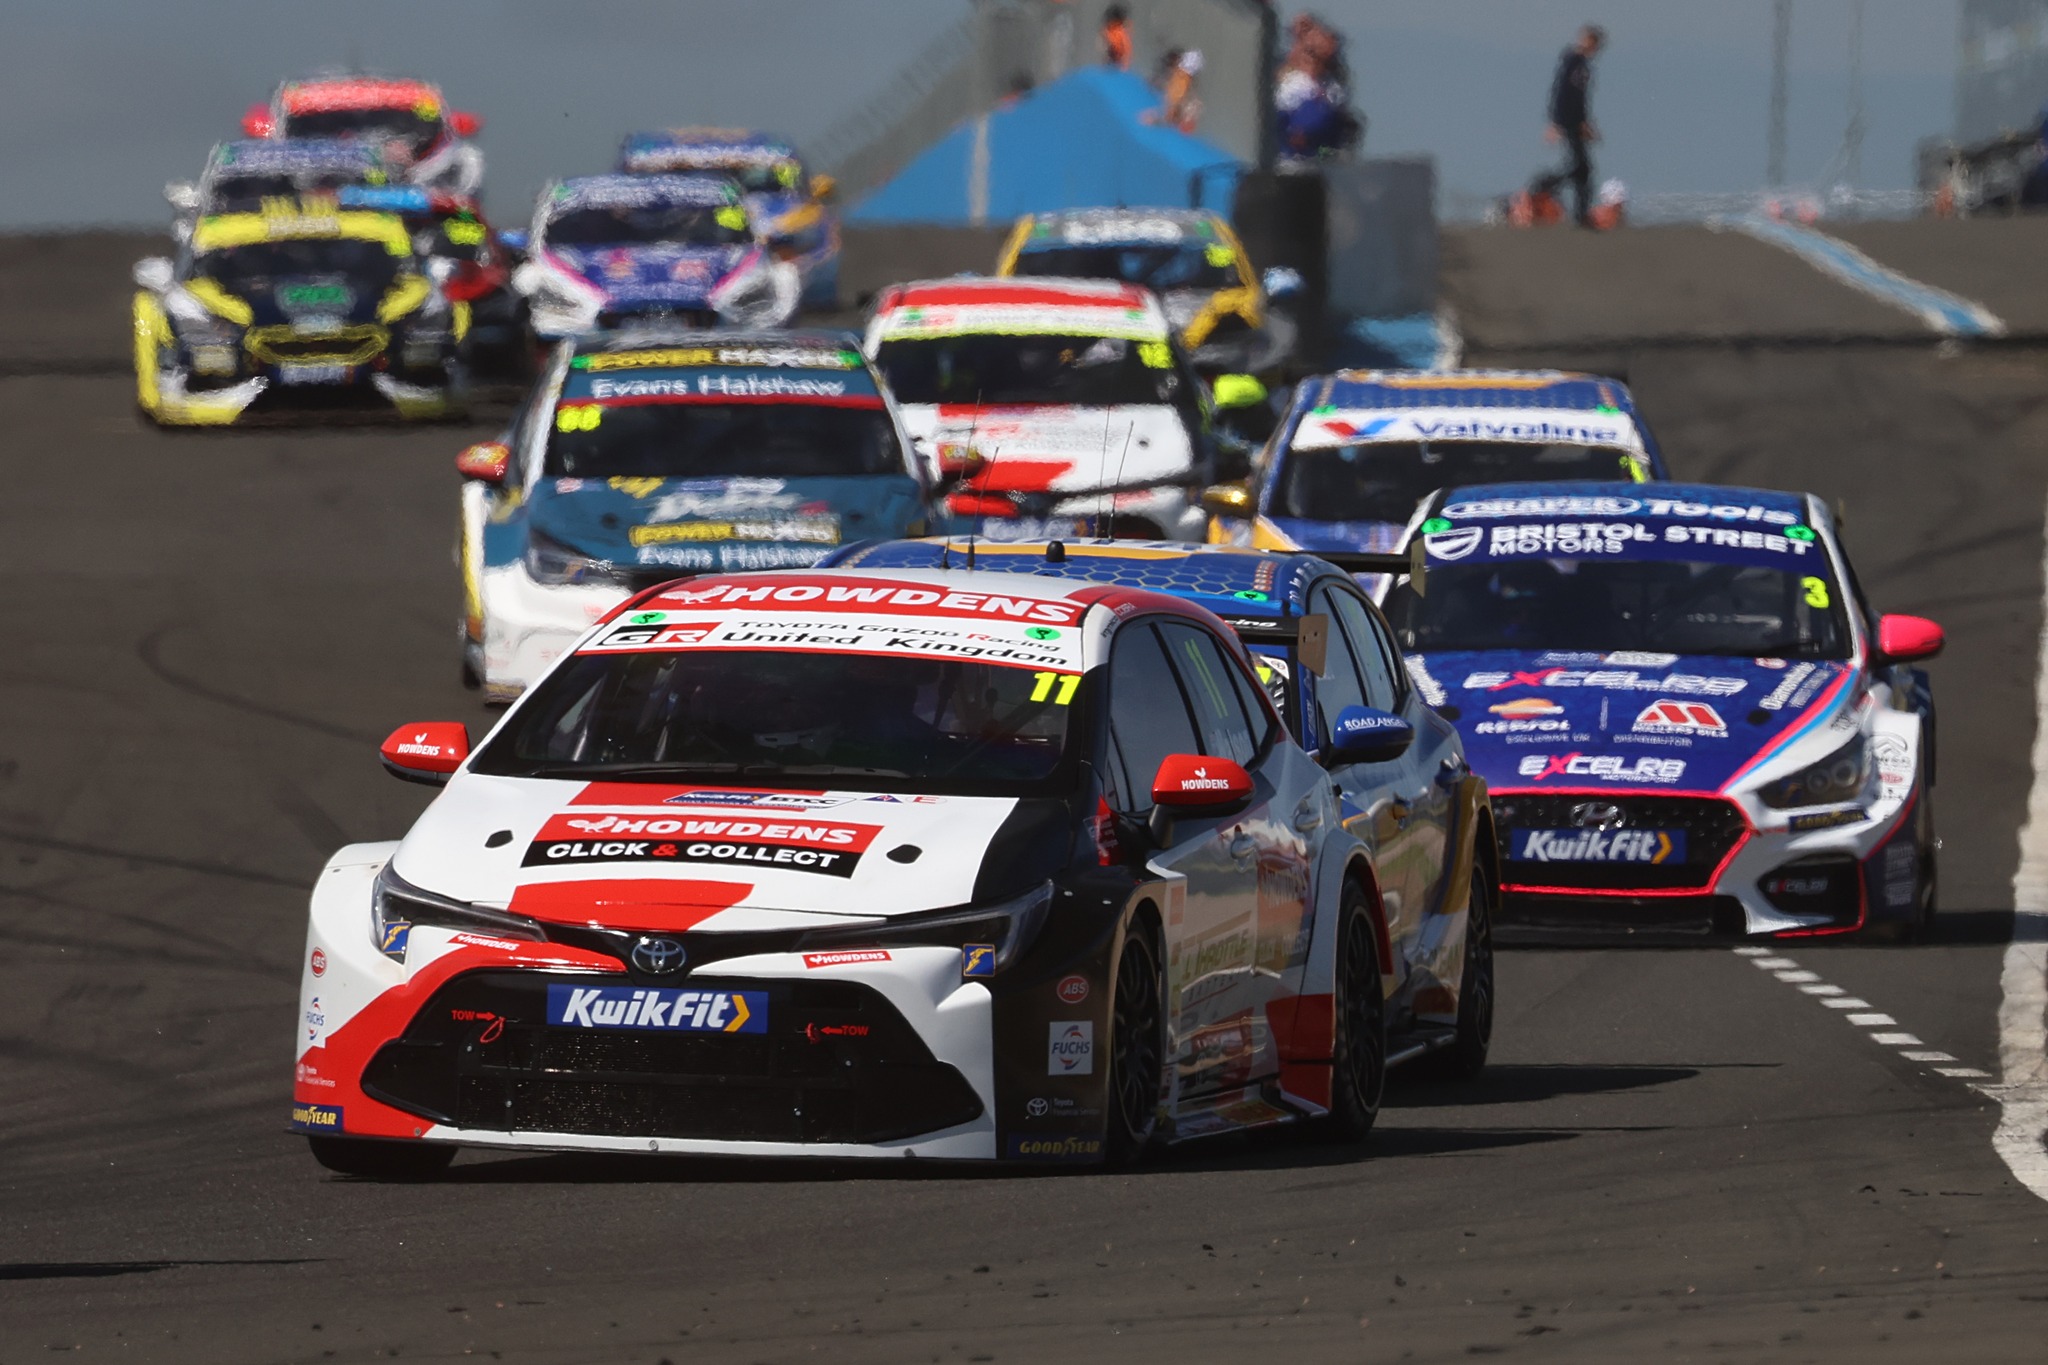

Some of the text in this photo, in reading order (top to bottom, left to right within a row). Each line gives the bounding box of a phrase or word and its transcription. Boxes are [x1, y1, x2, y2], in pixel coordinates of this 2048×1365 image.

[590, 374, 846, 398] Evans Halshaw
[1413, 422, 1618, 441] Valvoline
[1645, 498, 1799, 525] Tools
[1489, 537, 1624, 557] MOTORS
[1491, 522, 1814, 555] BRISTOL STREET
[1801, 576, 1829, 609] 3
[720, 585, 1075, 623] HOWDENS
[602, 629, 709, 645] GR
[738, 621, 1061, 652] TOYOTA GAZOO Racing
[722, 631, 1068, 665] United Kingdom
[1030, 671, 1082, 706] 11
[1344, 717, 1376, 731] ROAD
[397, 743, 441, 756] HOWDENS
[1181, 778, 1230, 790] HOWDENS
[611, 818, 858, 844] HOWDENS
[546, 842, 840, 868] CLICK & COLLECT
[464, 935, 520, 951] HOWDENS
[820, 952, 886, 964] HOWDENS
[1063, 982, 1086, 995] ABS
[451, 1010, 475, 1021] TOW
[841, 1024, 869, 1036] TOW
[1051, 1041, 1091, 1055] FUCHS
[293, 1106, 337, 1127] GOODYEAR
[1019, 1137, 1100, 1156] GOODYEAR
